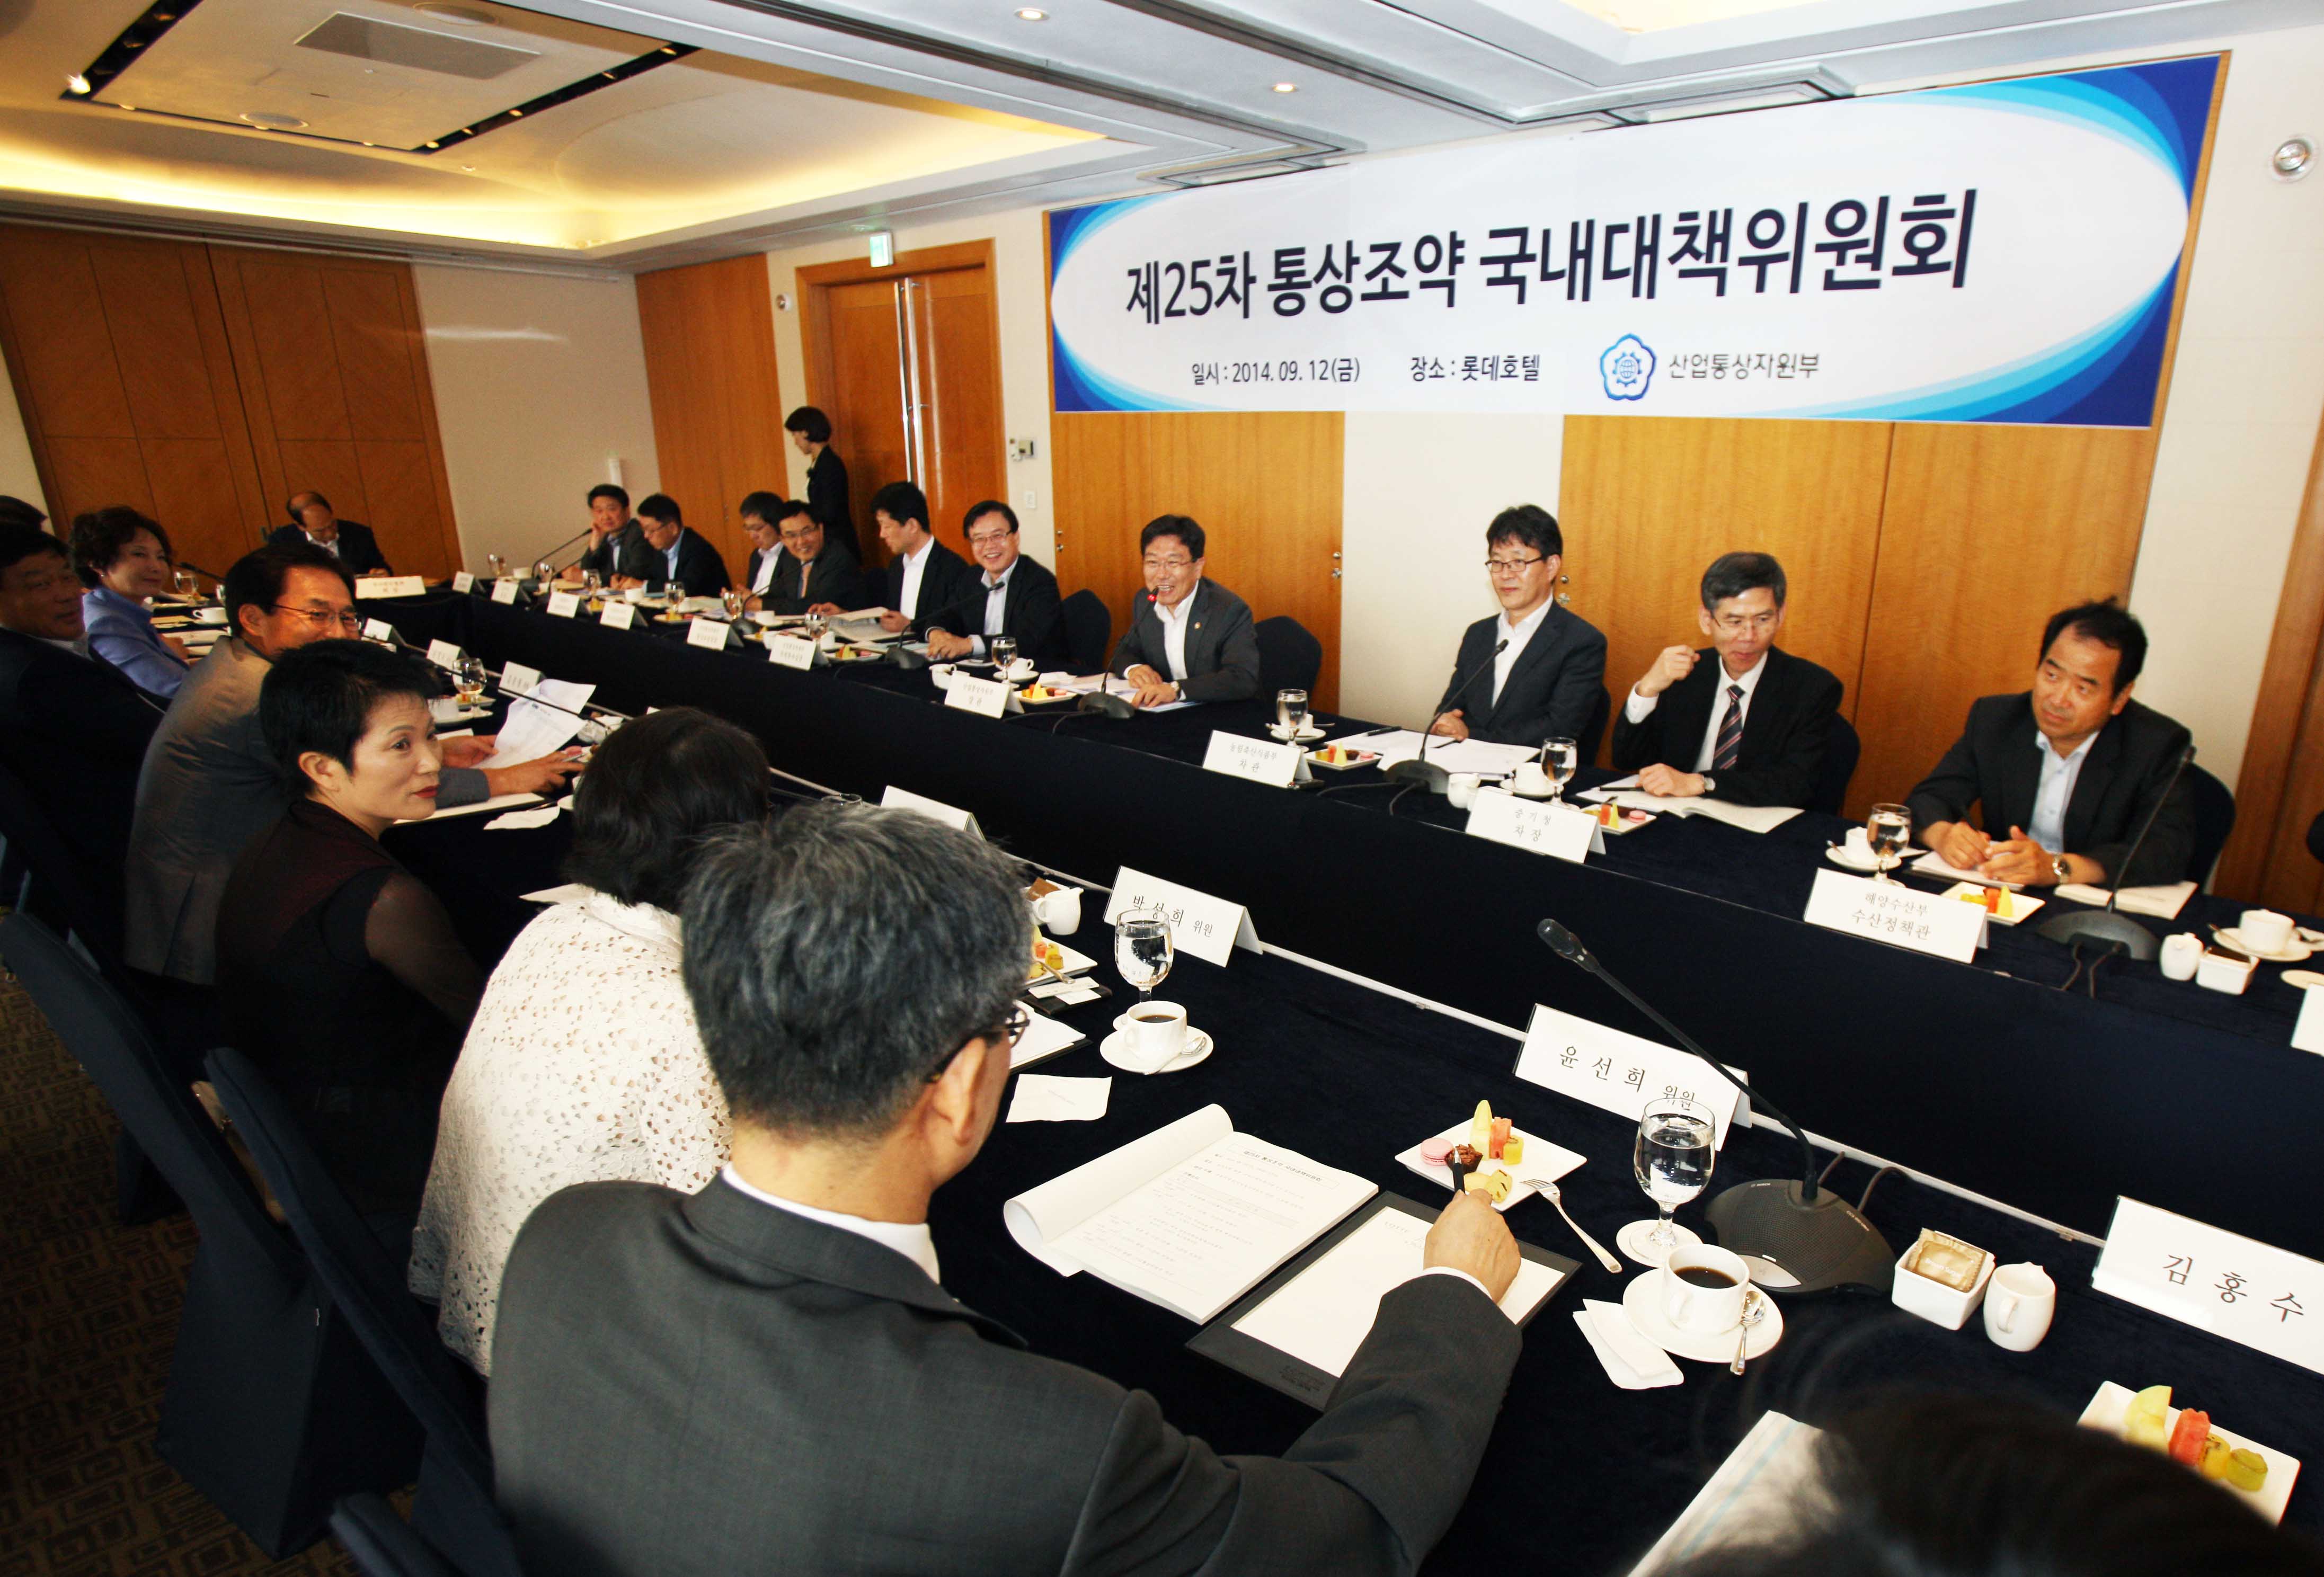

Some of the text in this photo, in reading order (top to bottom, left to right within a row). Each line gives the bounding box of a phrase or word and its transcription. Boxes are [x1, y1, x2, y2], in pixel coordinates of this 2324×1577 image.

[1126, 189, 1977, 324] 제25차 통상조약 국내대책위원회
[1460, 354, 1540, 381] 롯데호텔
[1669, 353, 1819, 380] 산업통상자원부
[1865, 892, 1928, 916] 해양수산부
[1193, 920, 1213, 938] 위원
[1852, 908, 1930, 940] 수산정책관
